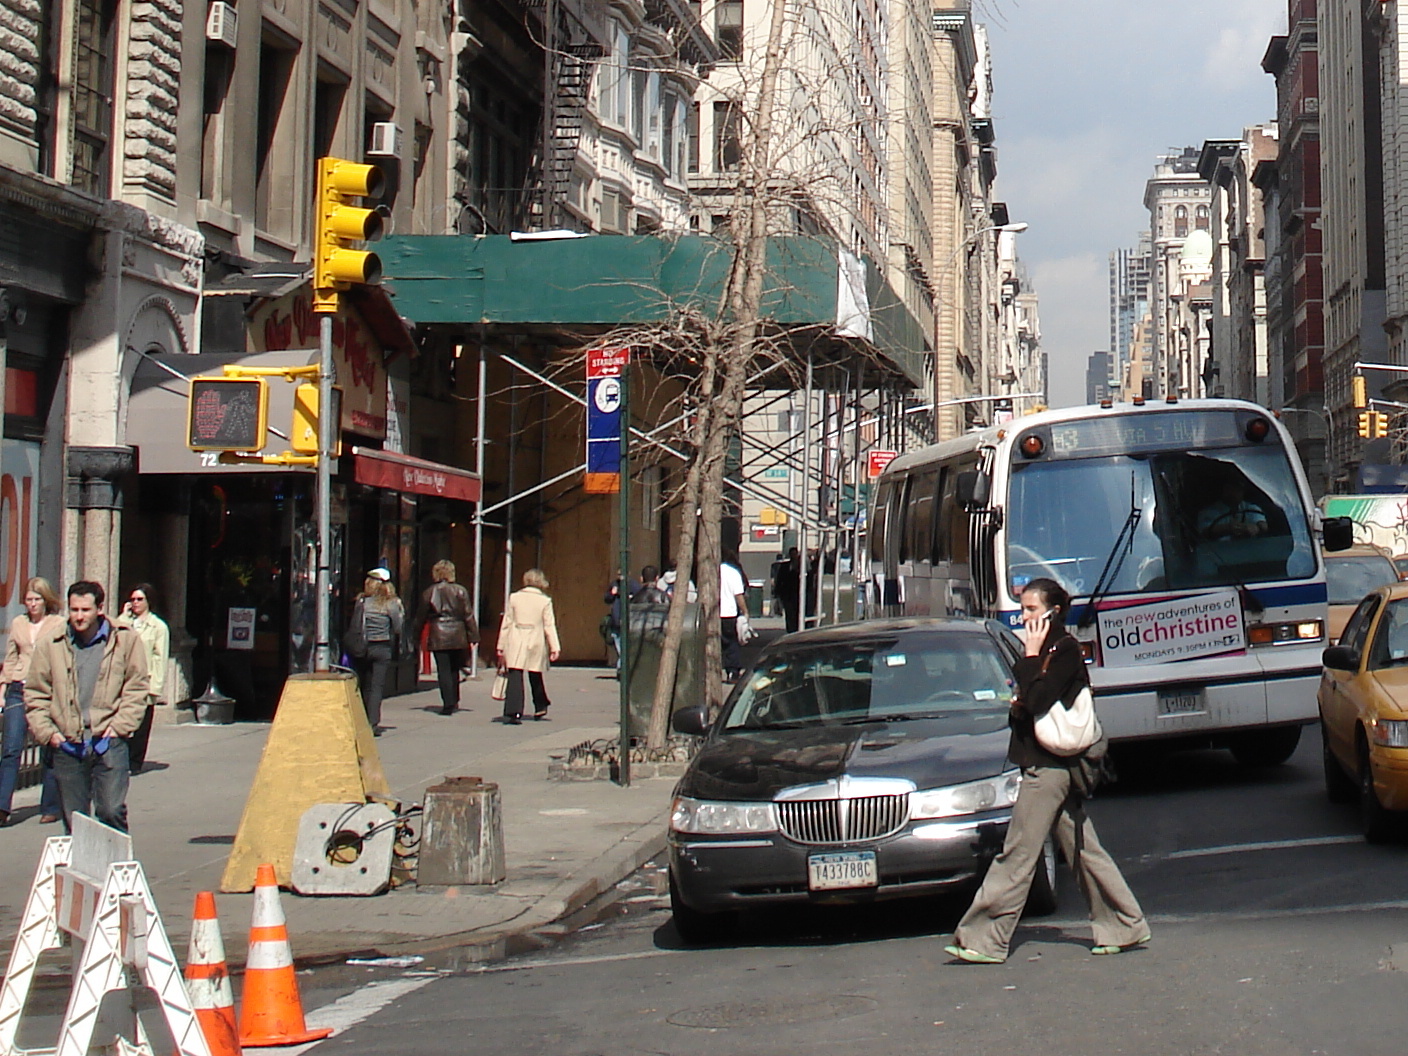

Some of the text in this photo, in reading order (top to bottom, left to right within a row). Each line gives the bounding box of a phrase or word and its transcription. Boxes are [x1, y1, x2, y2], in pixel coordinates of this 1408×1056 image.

[592, 357, 625, 367] STANDING
[200, 453, 217, 467] 72
[1103, 596, 1235, 629] the new adventures of
[1105, 613, 1238, 650] old christine
[1134, 647, 1175, 661] MONDAYS
[815, 862, 871, 881] T433788C
